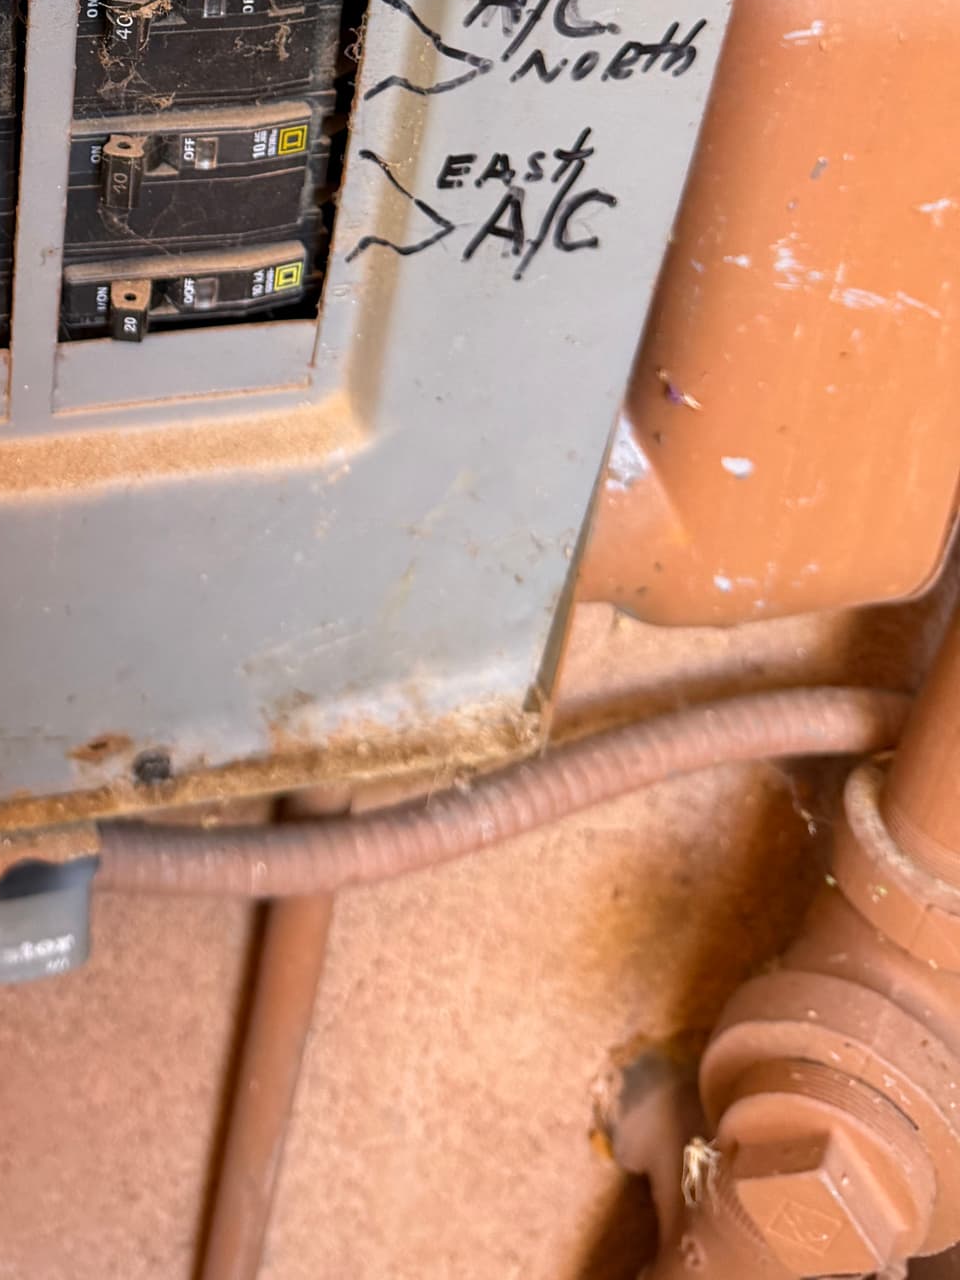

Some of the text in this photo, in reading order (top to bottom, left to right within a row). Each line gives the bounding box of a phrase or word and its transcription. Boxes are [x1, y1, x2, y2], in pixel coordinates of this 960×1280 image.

[114, 15, 134, 40] 40
[90, 145, 102, 164] ON
[183, 137, 196, 161] OFF
[462, 159, 619, 281] A/C
[123, 317, 137, 332] 20
